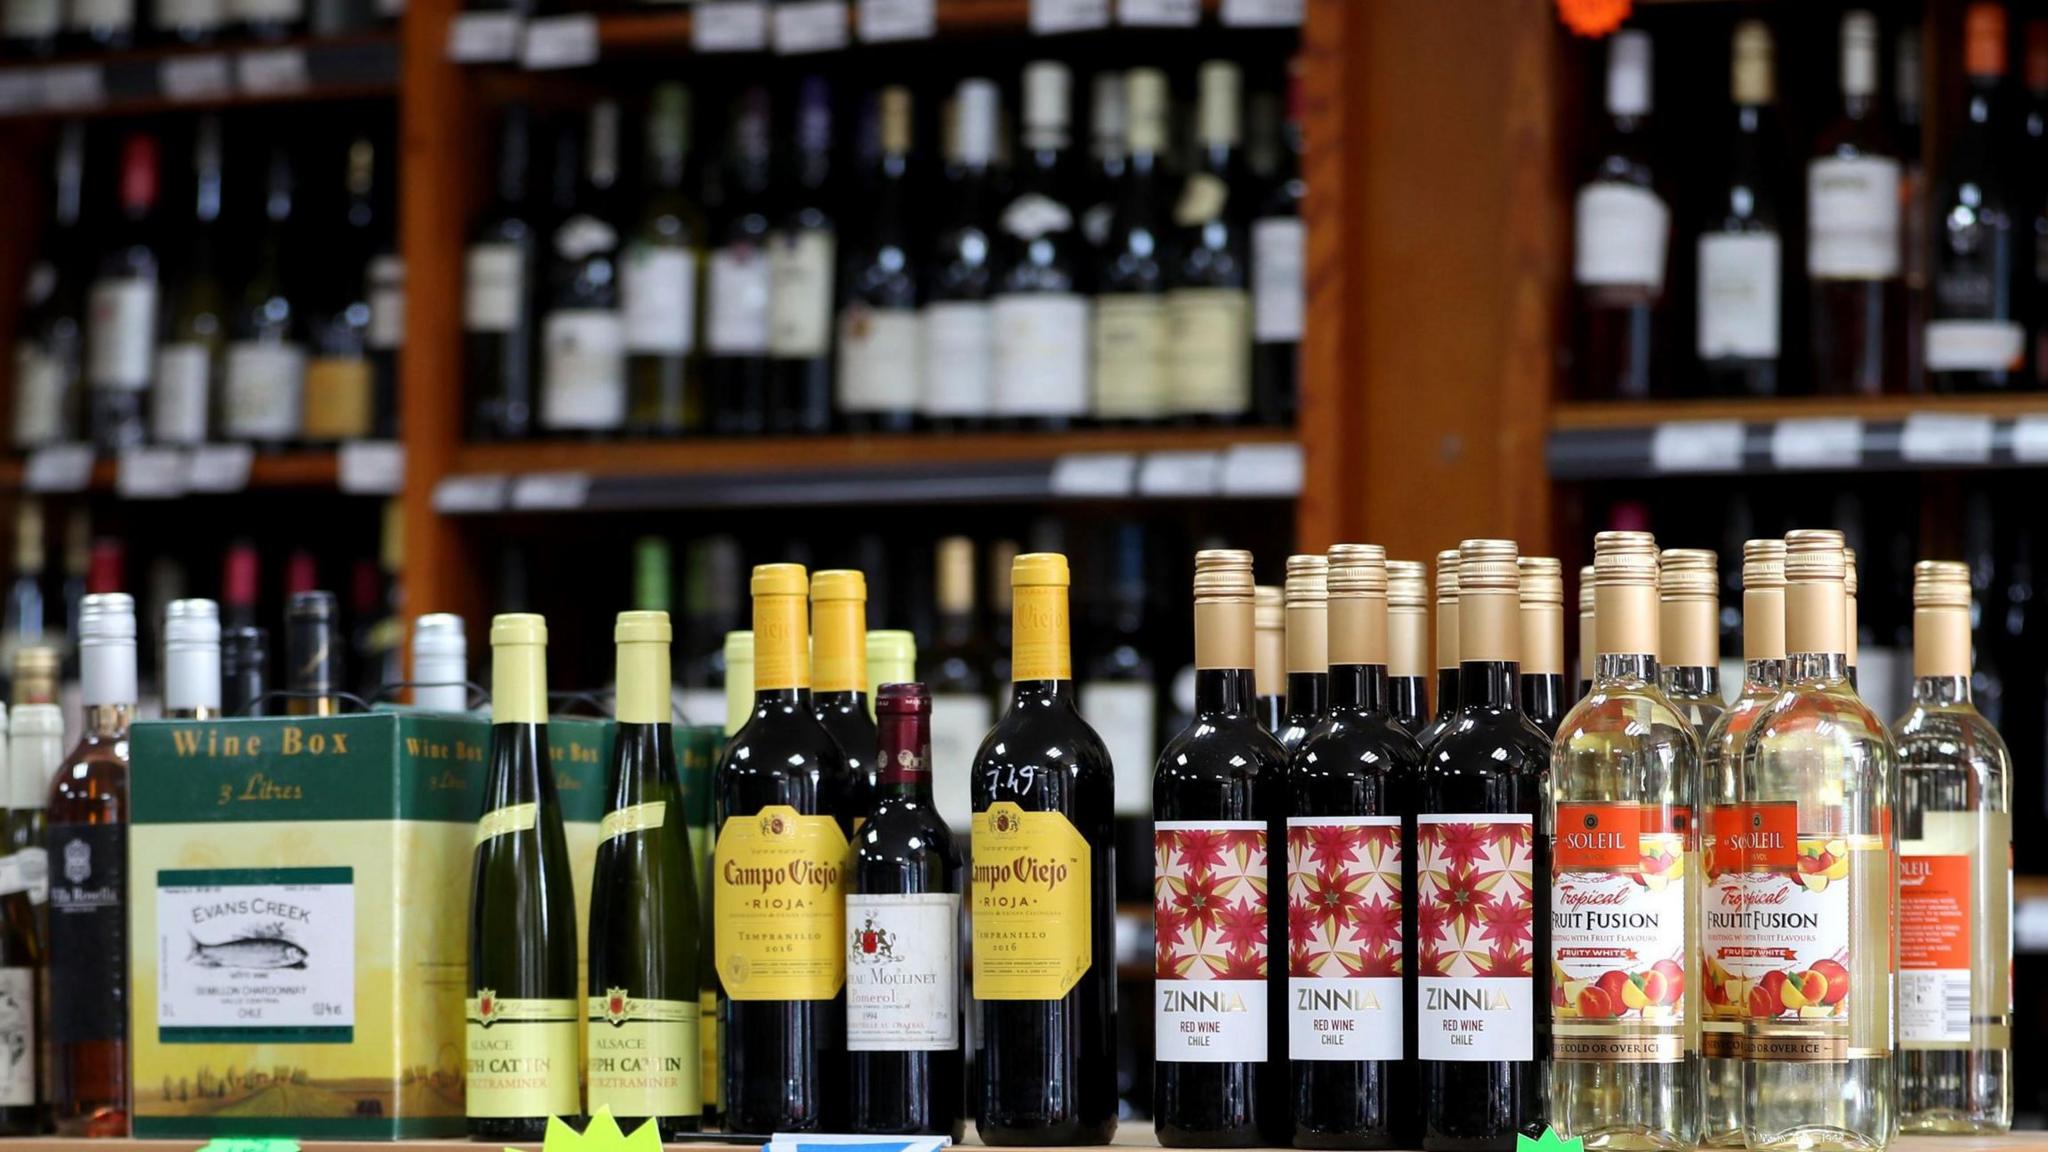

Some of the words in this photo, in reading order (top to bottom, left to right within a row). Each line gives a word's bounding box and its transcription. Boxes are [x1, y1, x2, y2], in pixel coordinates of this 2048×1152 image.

[172, 729, 262, 757] Wine
[281, 726, 349, 756] Box
[405, 736, 450, 760] Wine
[455, 740, 484, 763] Box
[217, 783, 232, 806] 3
[238, 771, 304, 802] Litres
[1567, 832, 1626, 849] SOLEIL
[724, 858, 786, 895] Campo
[788, 858, 838, 895] Viejo
[972, 856, 1011, 893] ampo
[1013, 856, 1067, 892] Viejo
[984, 897, 1029, 909] RIOJA
[1560, 882, 1634, 913] Tropical
[192, 899, 249, 924] EVANS
[250, 897, 312, 924] CREEK
[752, 898, 806, 911] RIOJA
[1551, 910, 1583, 930] FRUIT
[1586, 910, 1659, 931] FUSION
[1754, 910, 1818, 931] FUSION
[738, 930, 822, 942] TEMPRANILLO
[1572, 934, 1589, 942] WITH
[1591, 934, 1614, 943] FRUIT
[1617, 934, 1658, 943] FLAVOURS
[1778, 933, 1816, 942] FLAVOURS
[765, 943, 794, 954] 2016
[992, 942, 1017, 952] 2016
[1562, 948, 1590, 957] FRUITY
[1592, 949, 1626, 957] WHITE
[1759, 949, 1786, 957] WHITE
[871, 967, 937, 985] MOULINET
[1163, 990, 1247, 1012] ZINNIA
[1297, 988, 1381, 1011] ZINNIA
[1426, 987, 1511, 1011] ZINNIA
[1180, 1021, 1195, 1033] RED
[1198, 1021, 1220, 1033] WINE
[1313, 1019, 1329, 1031] RED
[1331, 1019, 1355, 1031] WINE
[1443, 1019, 1458, 1031] RED
[1460, 1019, 1483, 1031] WINE
[1188, 1036, 1210, 1046] CHILE
[1321, 1034, 1344, 1045] CHILE
[1450, 1034, 1473, 1045] CHILE
[1565, 1043, 1590, 1053] COLD
[1592, 1043, 1609, 1053] OR
[1610, 1044, 1641, 1053] OVER
[1769, 1044, 1797, 1053] OVER
[1800, 1044, 1820, 1053] ICE
